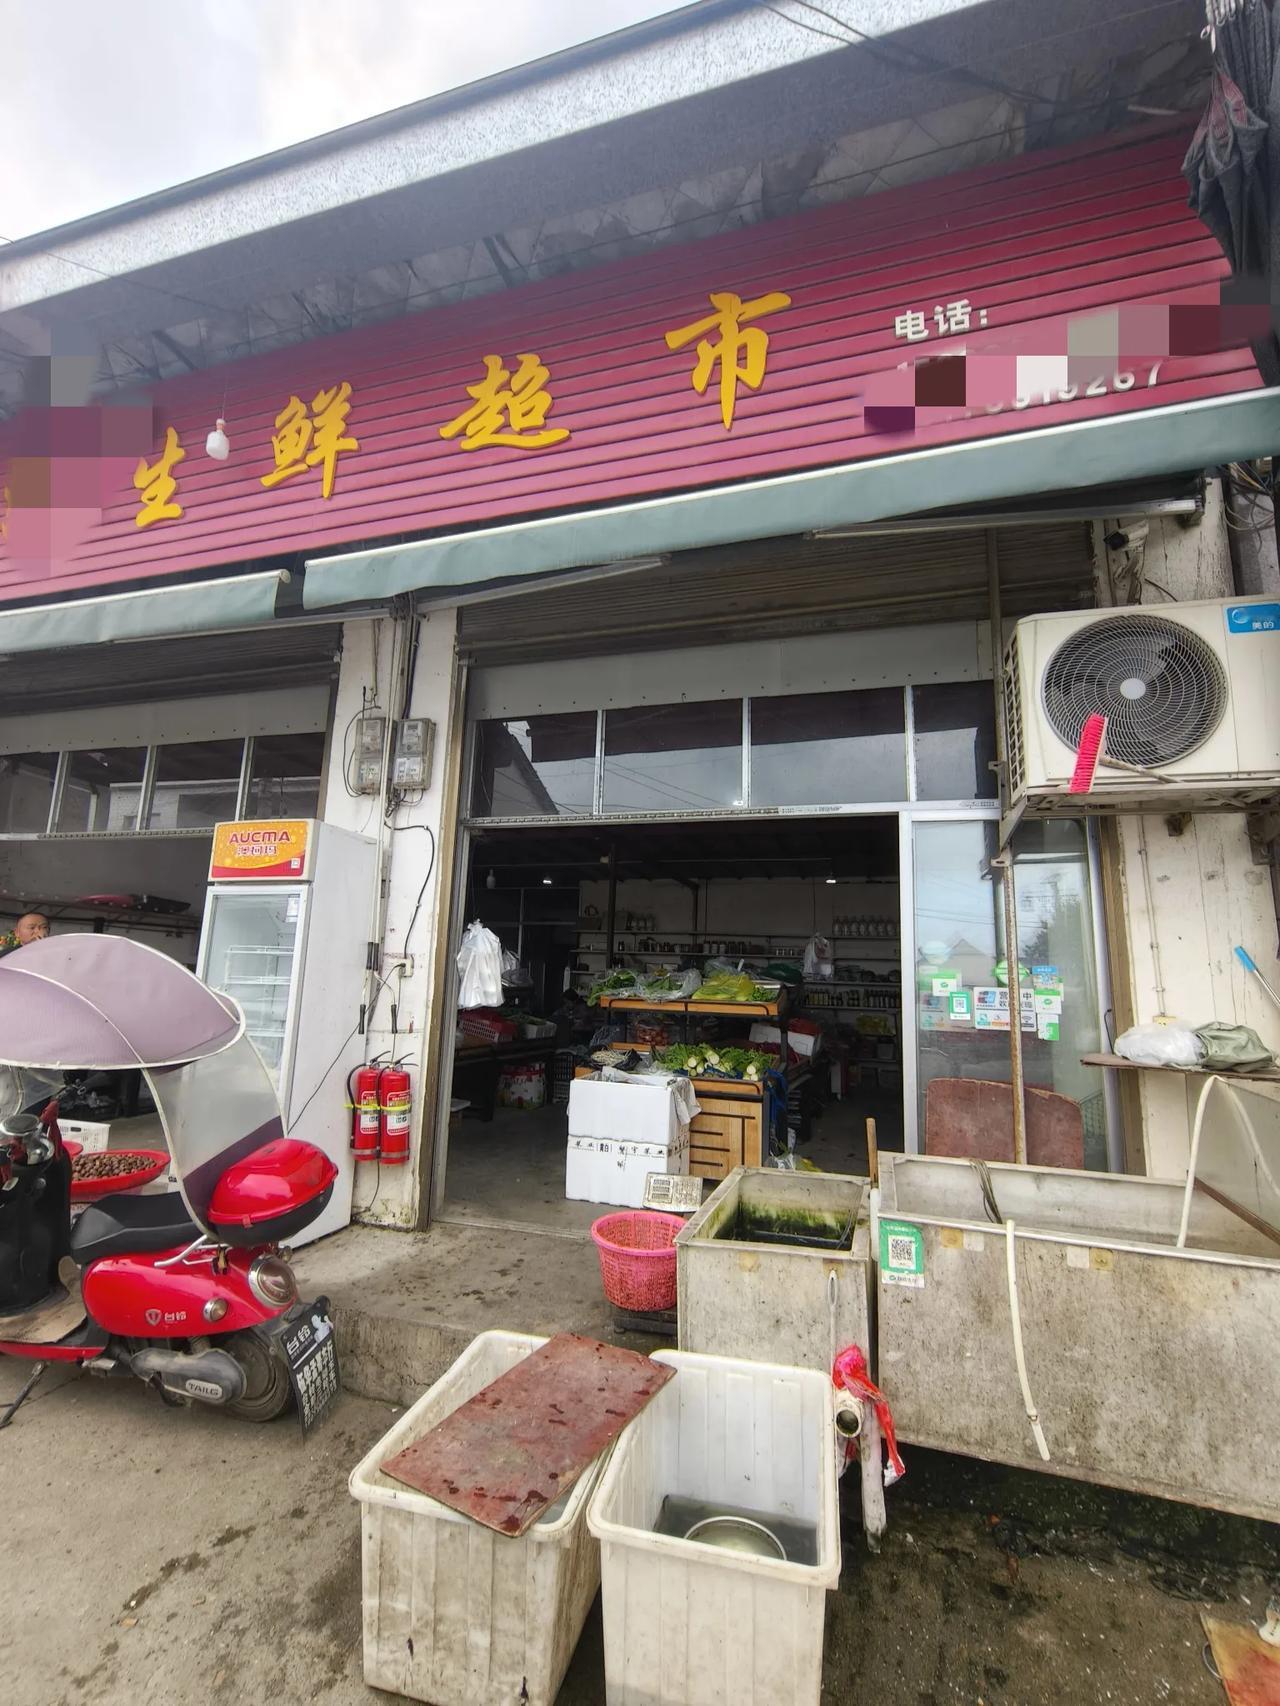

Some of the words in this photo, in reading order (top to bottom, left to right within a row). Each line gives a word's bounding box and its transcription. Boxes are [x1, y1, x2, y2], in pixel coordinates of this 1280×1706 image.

[895, 299, 988, 342] 电话：
[0, 292, 792, 541] 生鲜超市
[229, 830, 291, 844] AUCMA
[188, 1382, 219, 1396] TAILG
